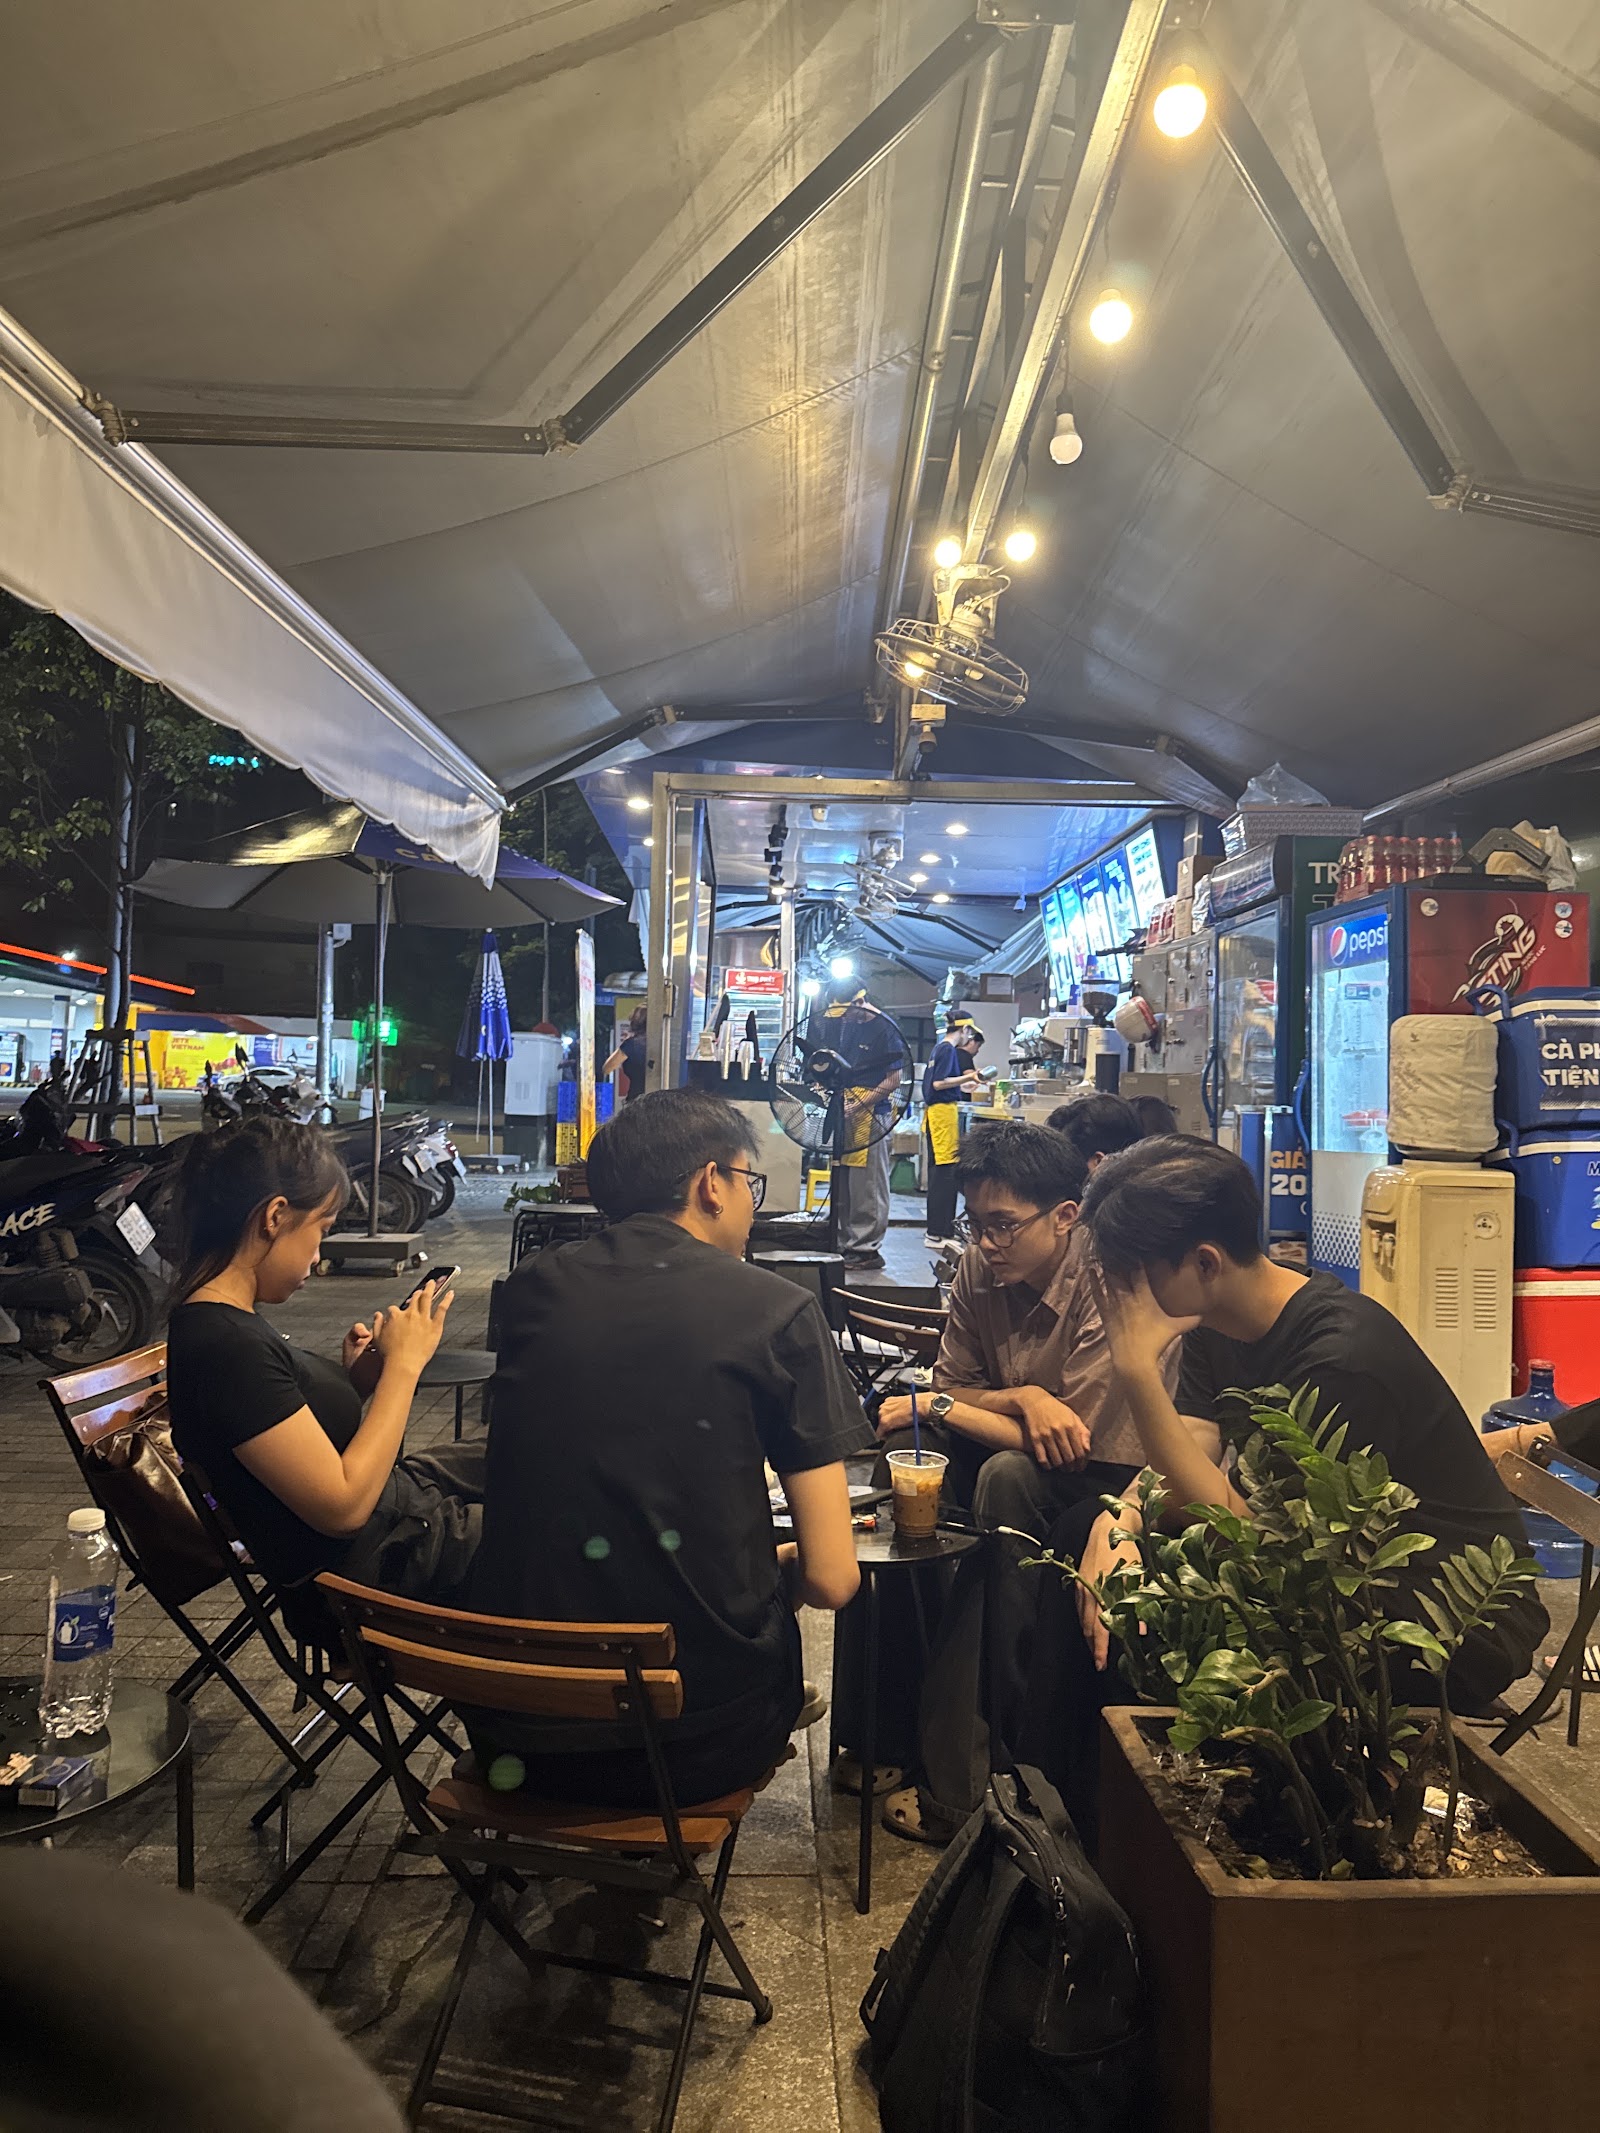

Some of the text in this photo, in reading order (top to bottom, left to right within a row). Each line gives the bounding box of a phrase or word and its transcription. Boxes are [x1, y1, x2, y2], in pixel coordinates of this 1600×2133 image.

[1350, 921, 1388, 958] pepsi
[1541, 1038, 1574, 1060] CÀ
[1543, 1064, 1600, 1089] TIỆN
[1271, 1173, 1307, 1196] 20
[0, 1202, 57, 1238] ACE
